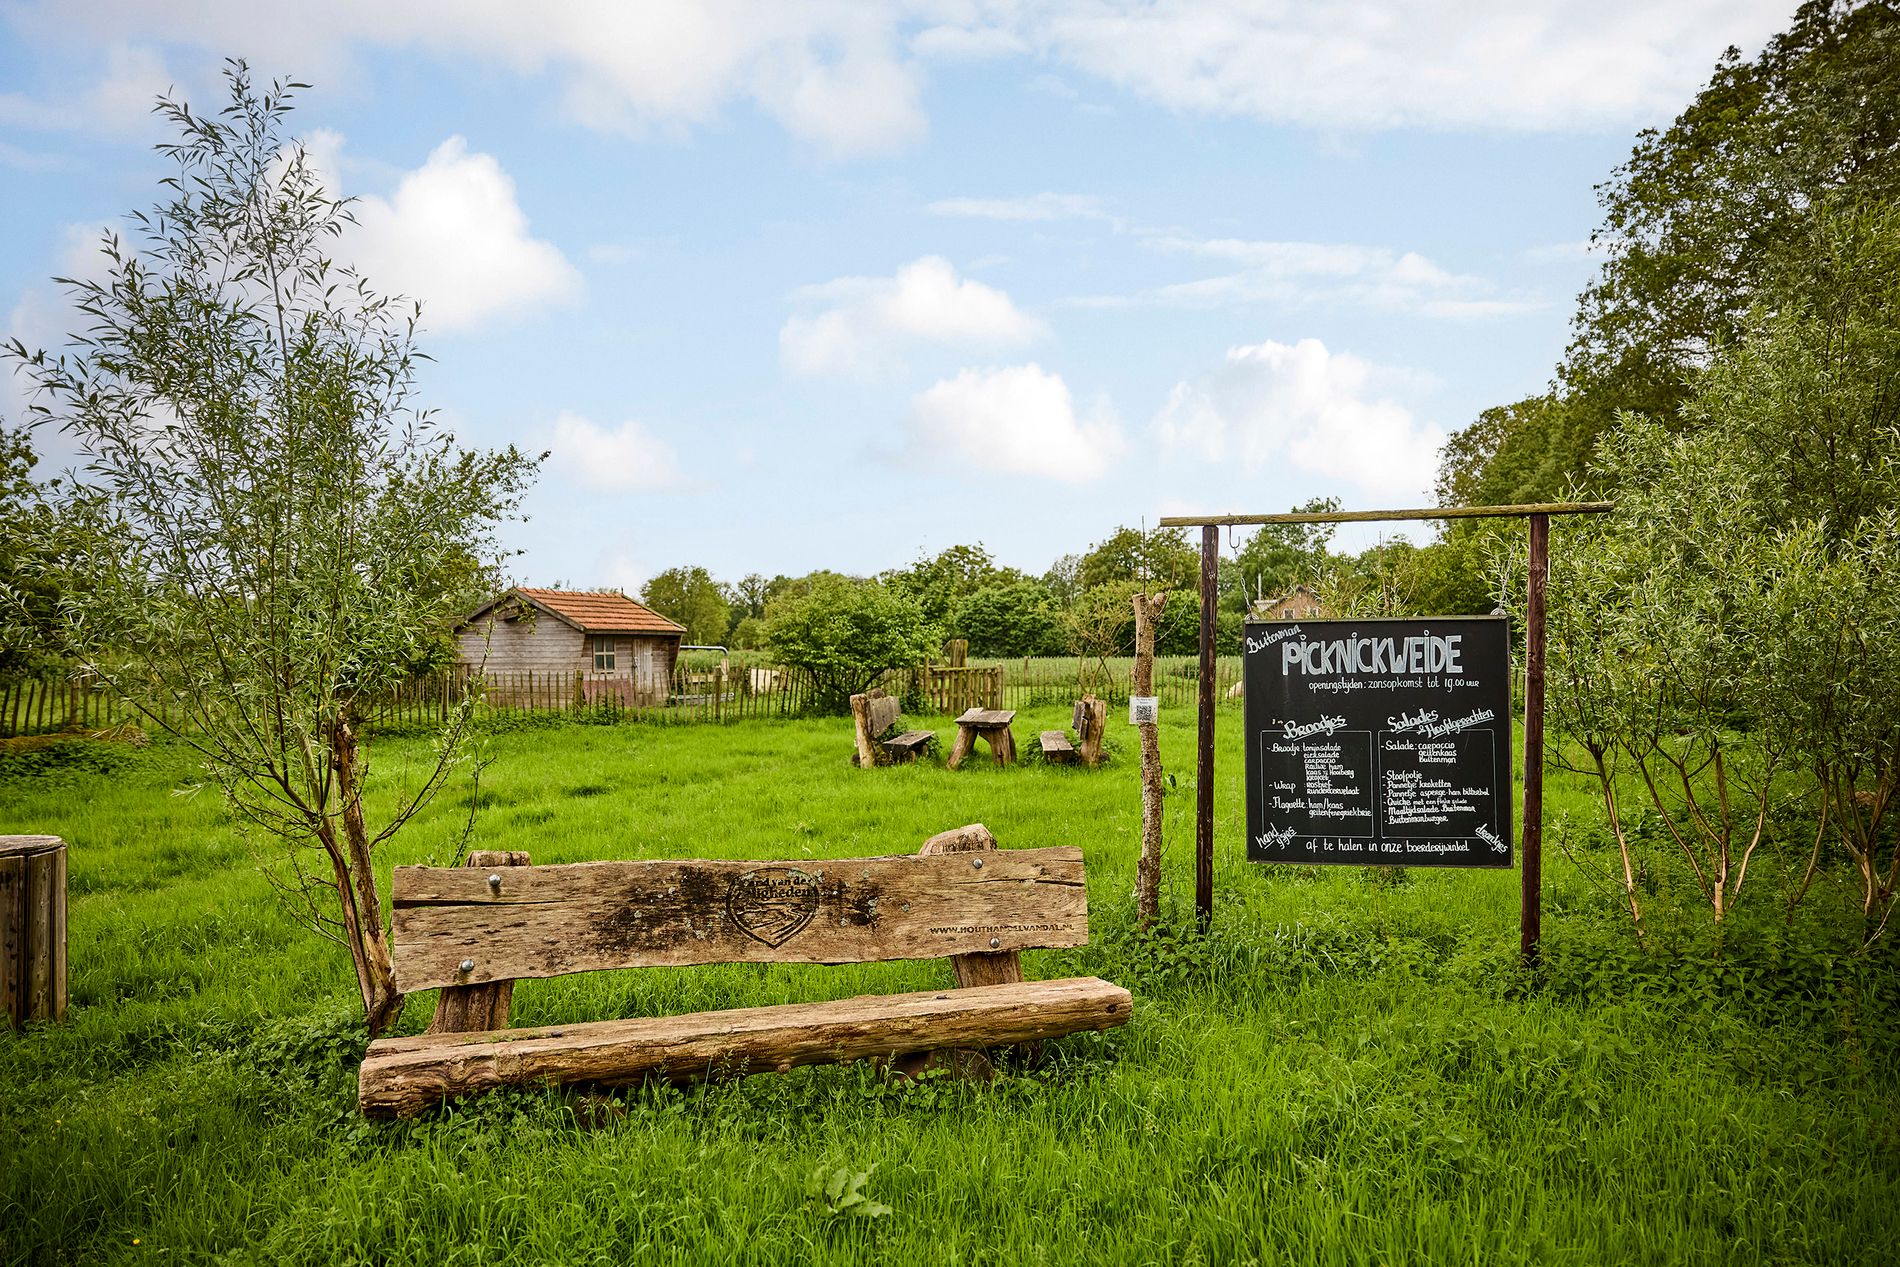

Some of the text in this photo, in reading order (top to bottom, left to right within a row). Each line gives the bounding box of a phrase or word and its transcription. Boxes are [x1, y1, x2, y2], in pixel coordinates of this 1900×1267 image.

[1368, 676, 1423, 692] zonsopkomst
[1427, 675, 1440, 688] tot
[1282, 713, 1348, 740] Broodjes
[1387, 707, 1439, 733] Salades
[1425, 707, 1495, 739] Hoofdgerechten
[1417, 740, 1456, 750] carpaccio
[1386, 769, 1423, 782] Stoofpotje
[1386, 780, 1417, 790] Pannetje
[1386, 789, 1417, 800] Pannetje
[1387, 798, 1412, 806] Quiche
[1305, 838, 1318, 853] af
[1323, 838, 1334, 851] te
[1338, 838, 1363, 851] halen
[1368, 841, 1378, 852] in
[1380, 842, 1404, 853] onze
[1474, 822, 1509, 854] drankjes
